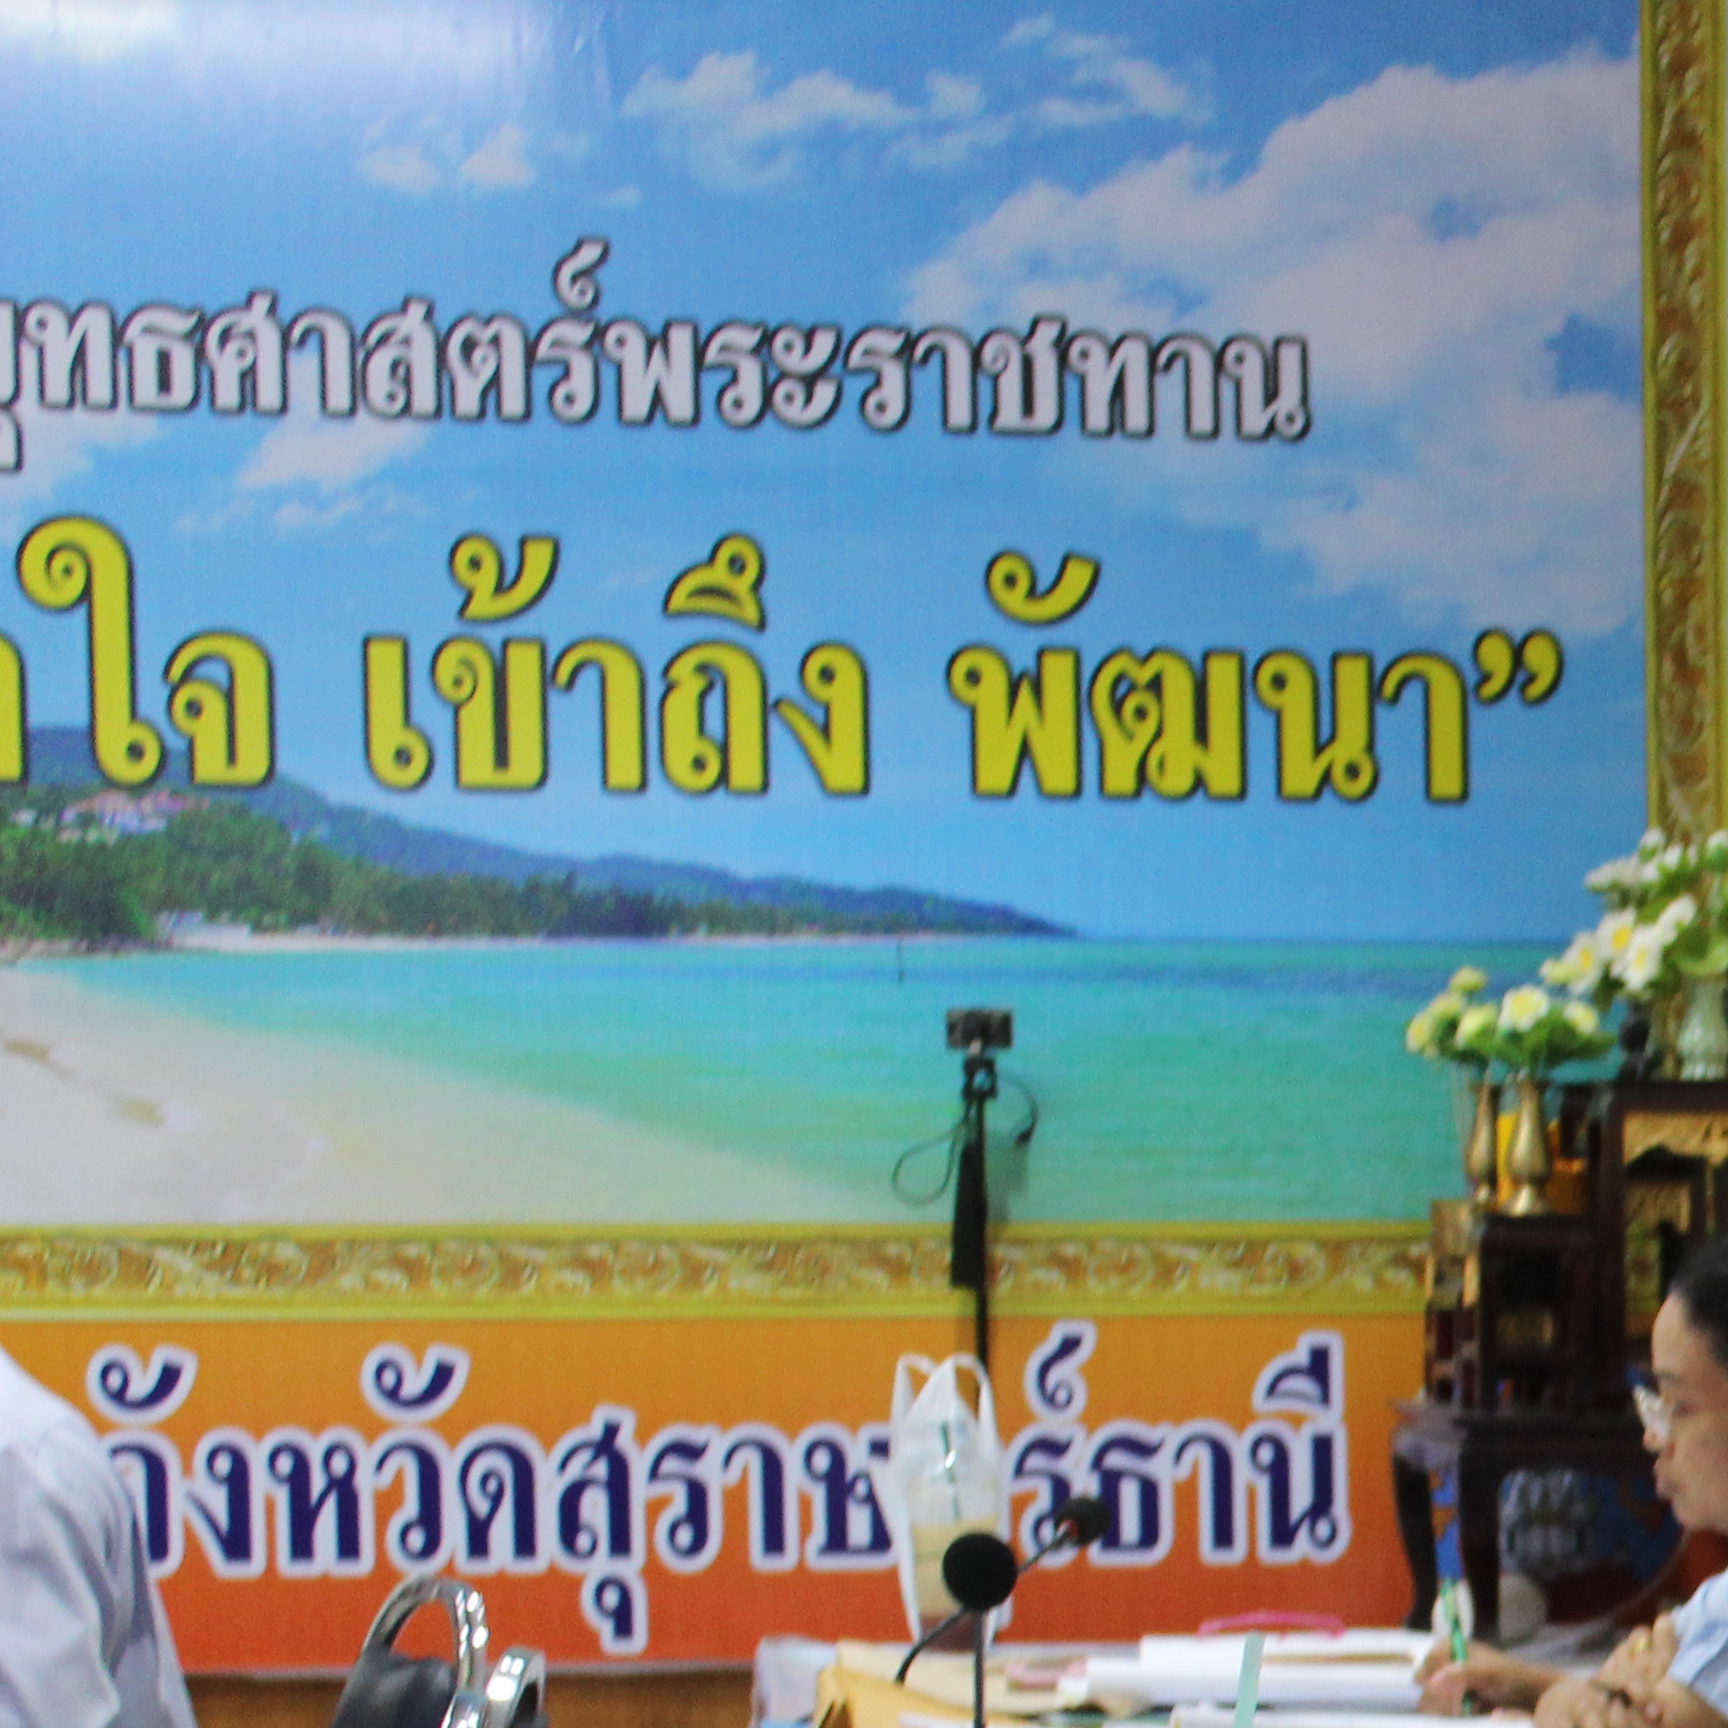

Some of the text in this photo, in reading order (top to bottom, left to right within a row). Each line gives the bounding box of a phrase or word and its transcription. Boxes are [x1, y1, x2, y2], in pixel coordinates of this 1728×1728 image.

[0, 237, 1311, 472] ุทธศาสตร์พระราชทาน
[362, 534, 870, 796] เข้าถึง
